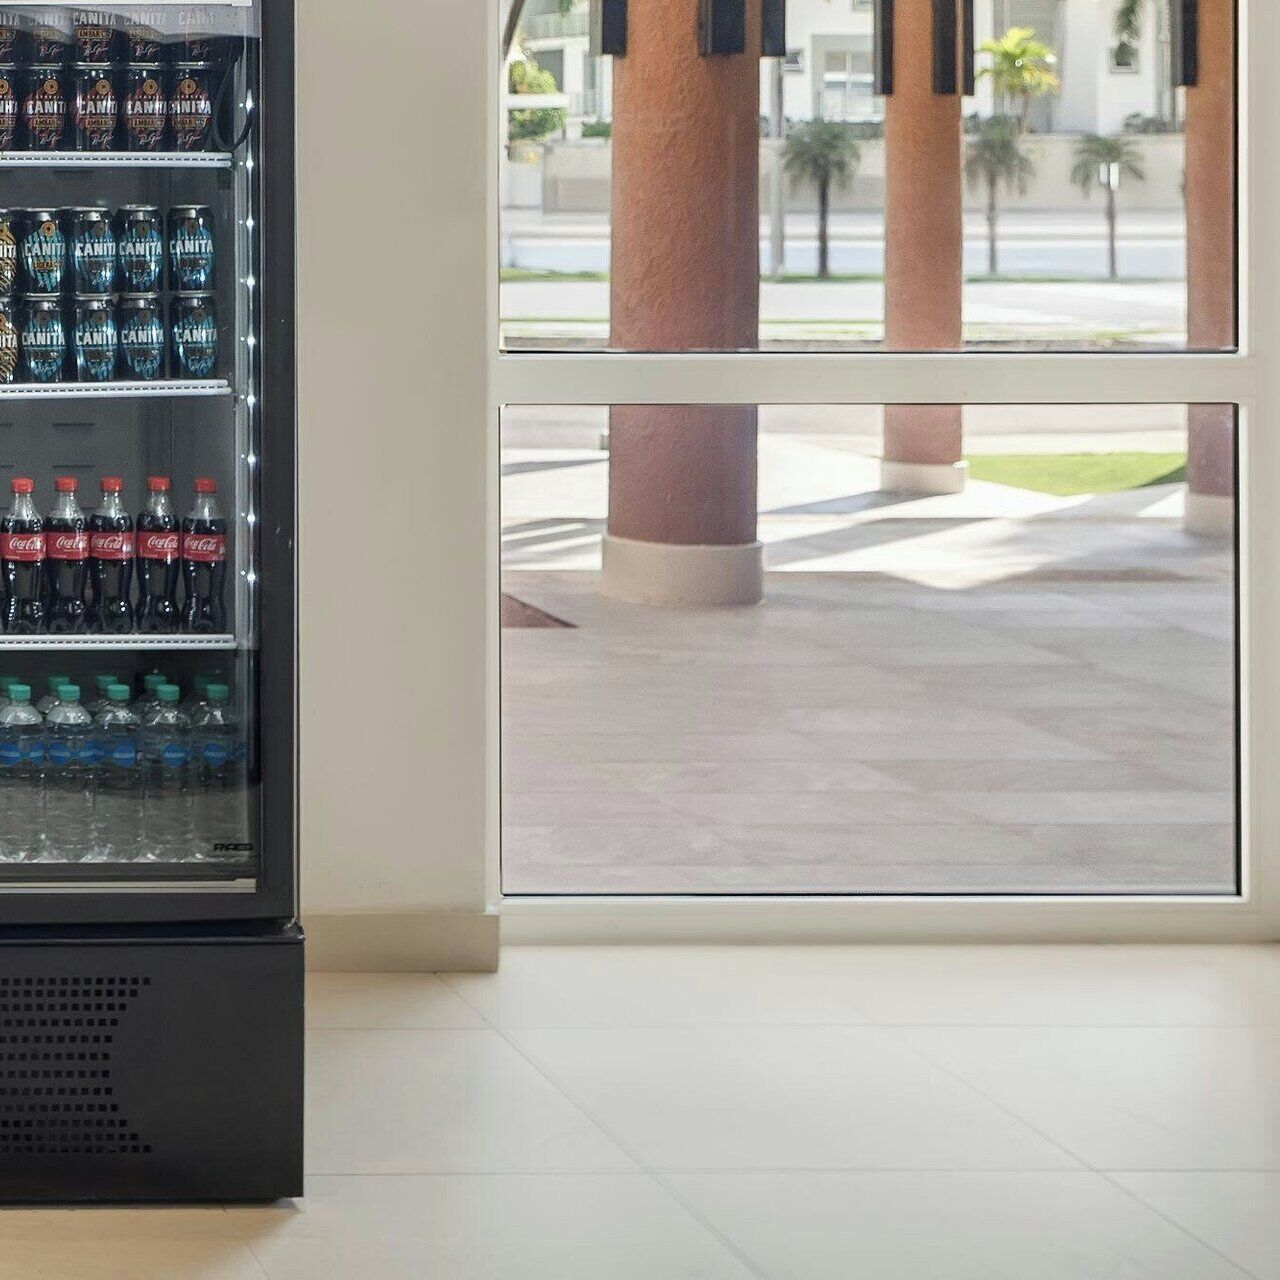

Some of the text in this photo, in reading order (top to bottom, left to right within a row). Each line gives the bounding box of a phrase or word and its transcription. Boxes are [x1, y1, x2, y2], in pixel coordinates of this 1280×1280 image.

[119, 241, 163, 256] CANITA
[169, 239, 214, 254] CANITA
[22, 331, 65, 346] CANITA
[121, 330, 164, 345] CANITA
